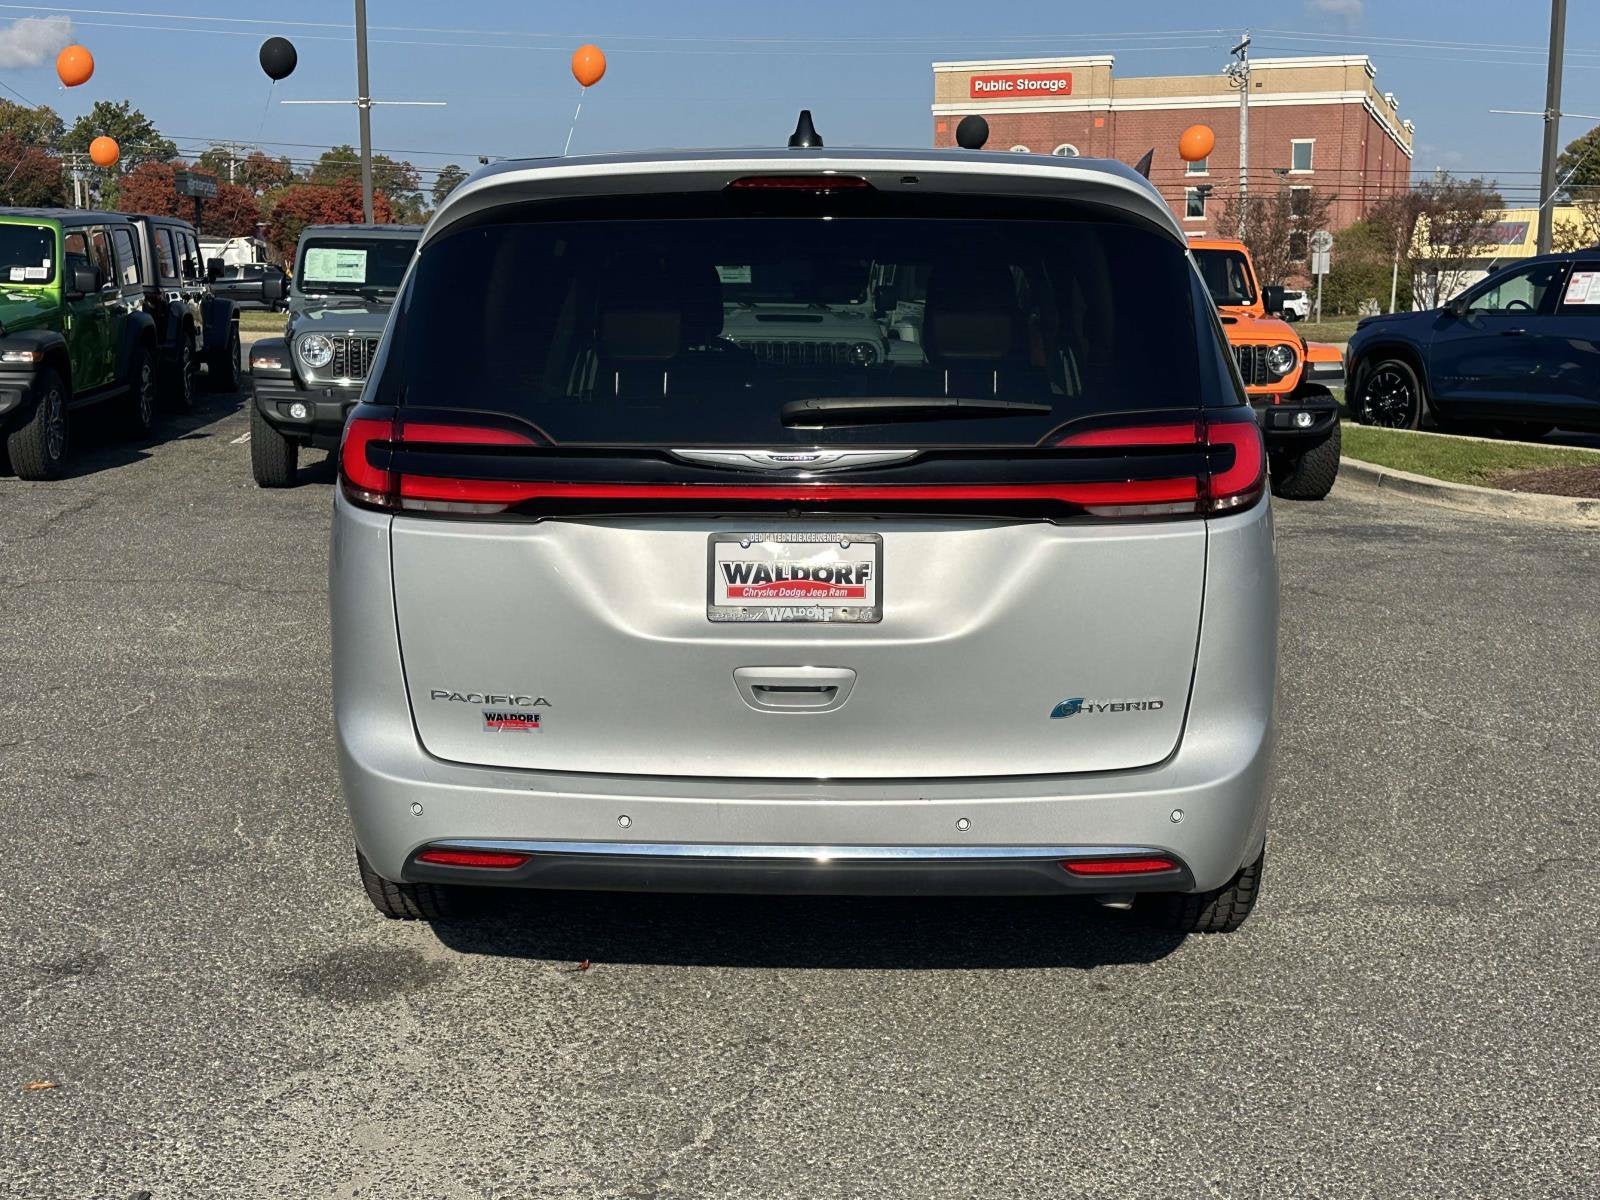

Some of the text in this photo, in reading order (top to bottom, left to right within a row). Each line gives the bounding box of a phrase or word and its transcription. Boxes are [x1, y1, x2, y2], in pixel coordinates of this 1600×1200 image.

[974, 78, 1067, 92] Public Storage
[721, 562, 871, 585] WALDORF
[743, 587, 848, 598] Chrysler Dodge Jeep Ram
[766, 607, 834, 622] WALDORF
[430, 689, 553, 707] PACIFICA
[484, 712, 541, 723] WALDORF
